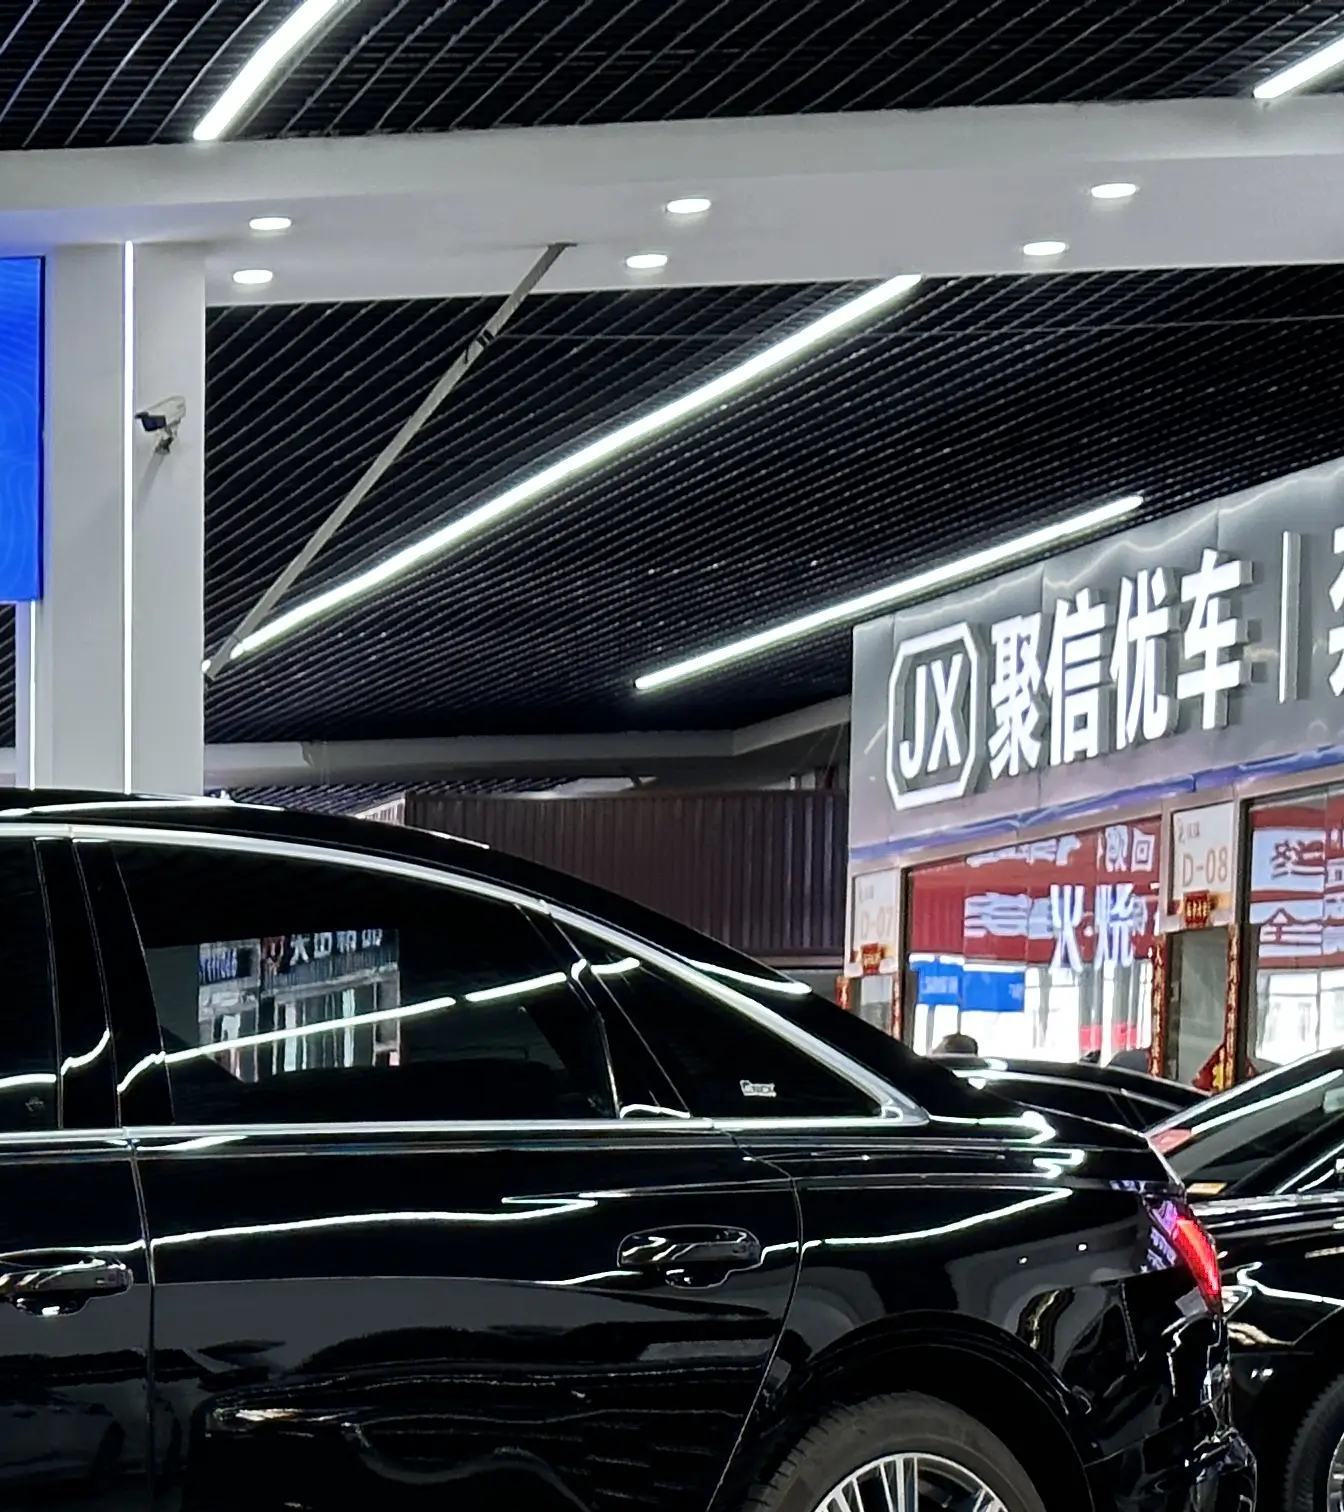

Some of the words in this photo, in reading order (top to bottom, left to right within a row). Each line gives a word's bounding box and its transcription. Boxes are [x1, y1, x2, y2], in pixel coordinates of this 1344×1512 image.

[899, 653, 963, 779] JX
[988, 548, 1244, 780] 聚信优车
[1181, 846, 1228, 887] D-08
